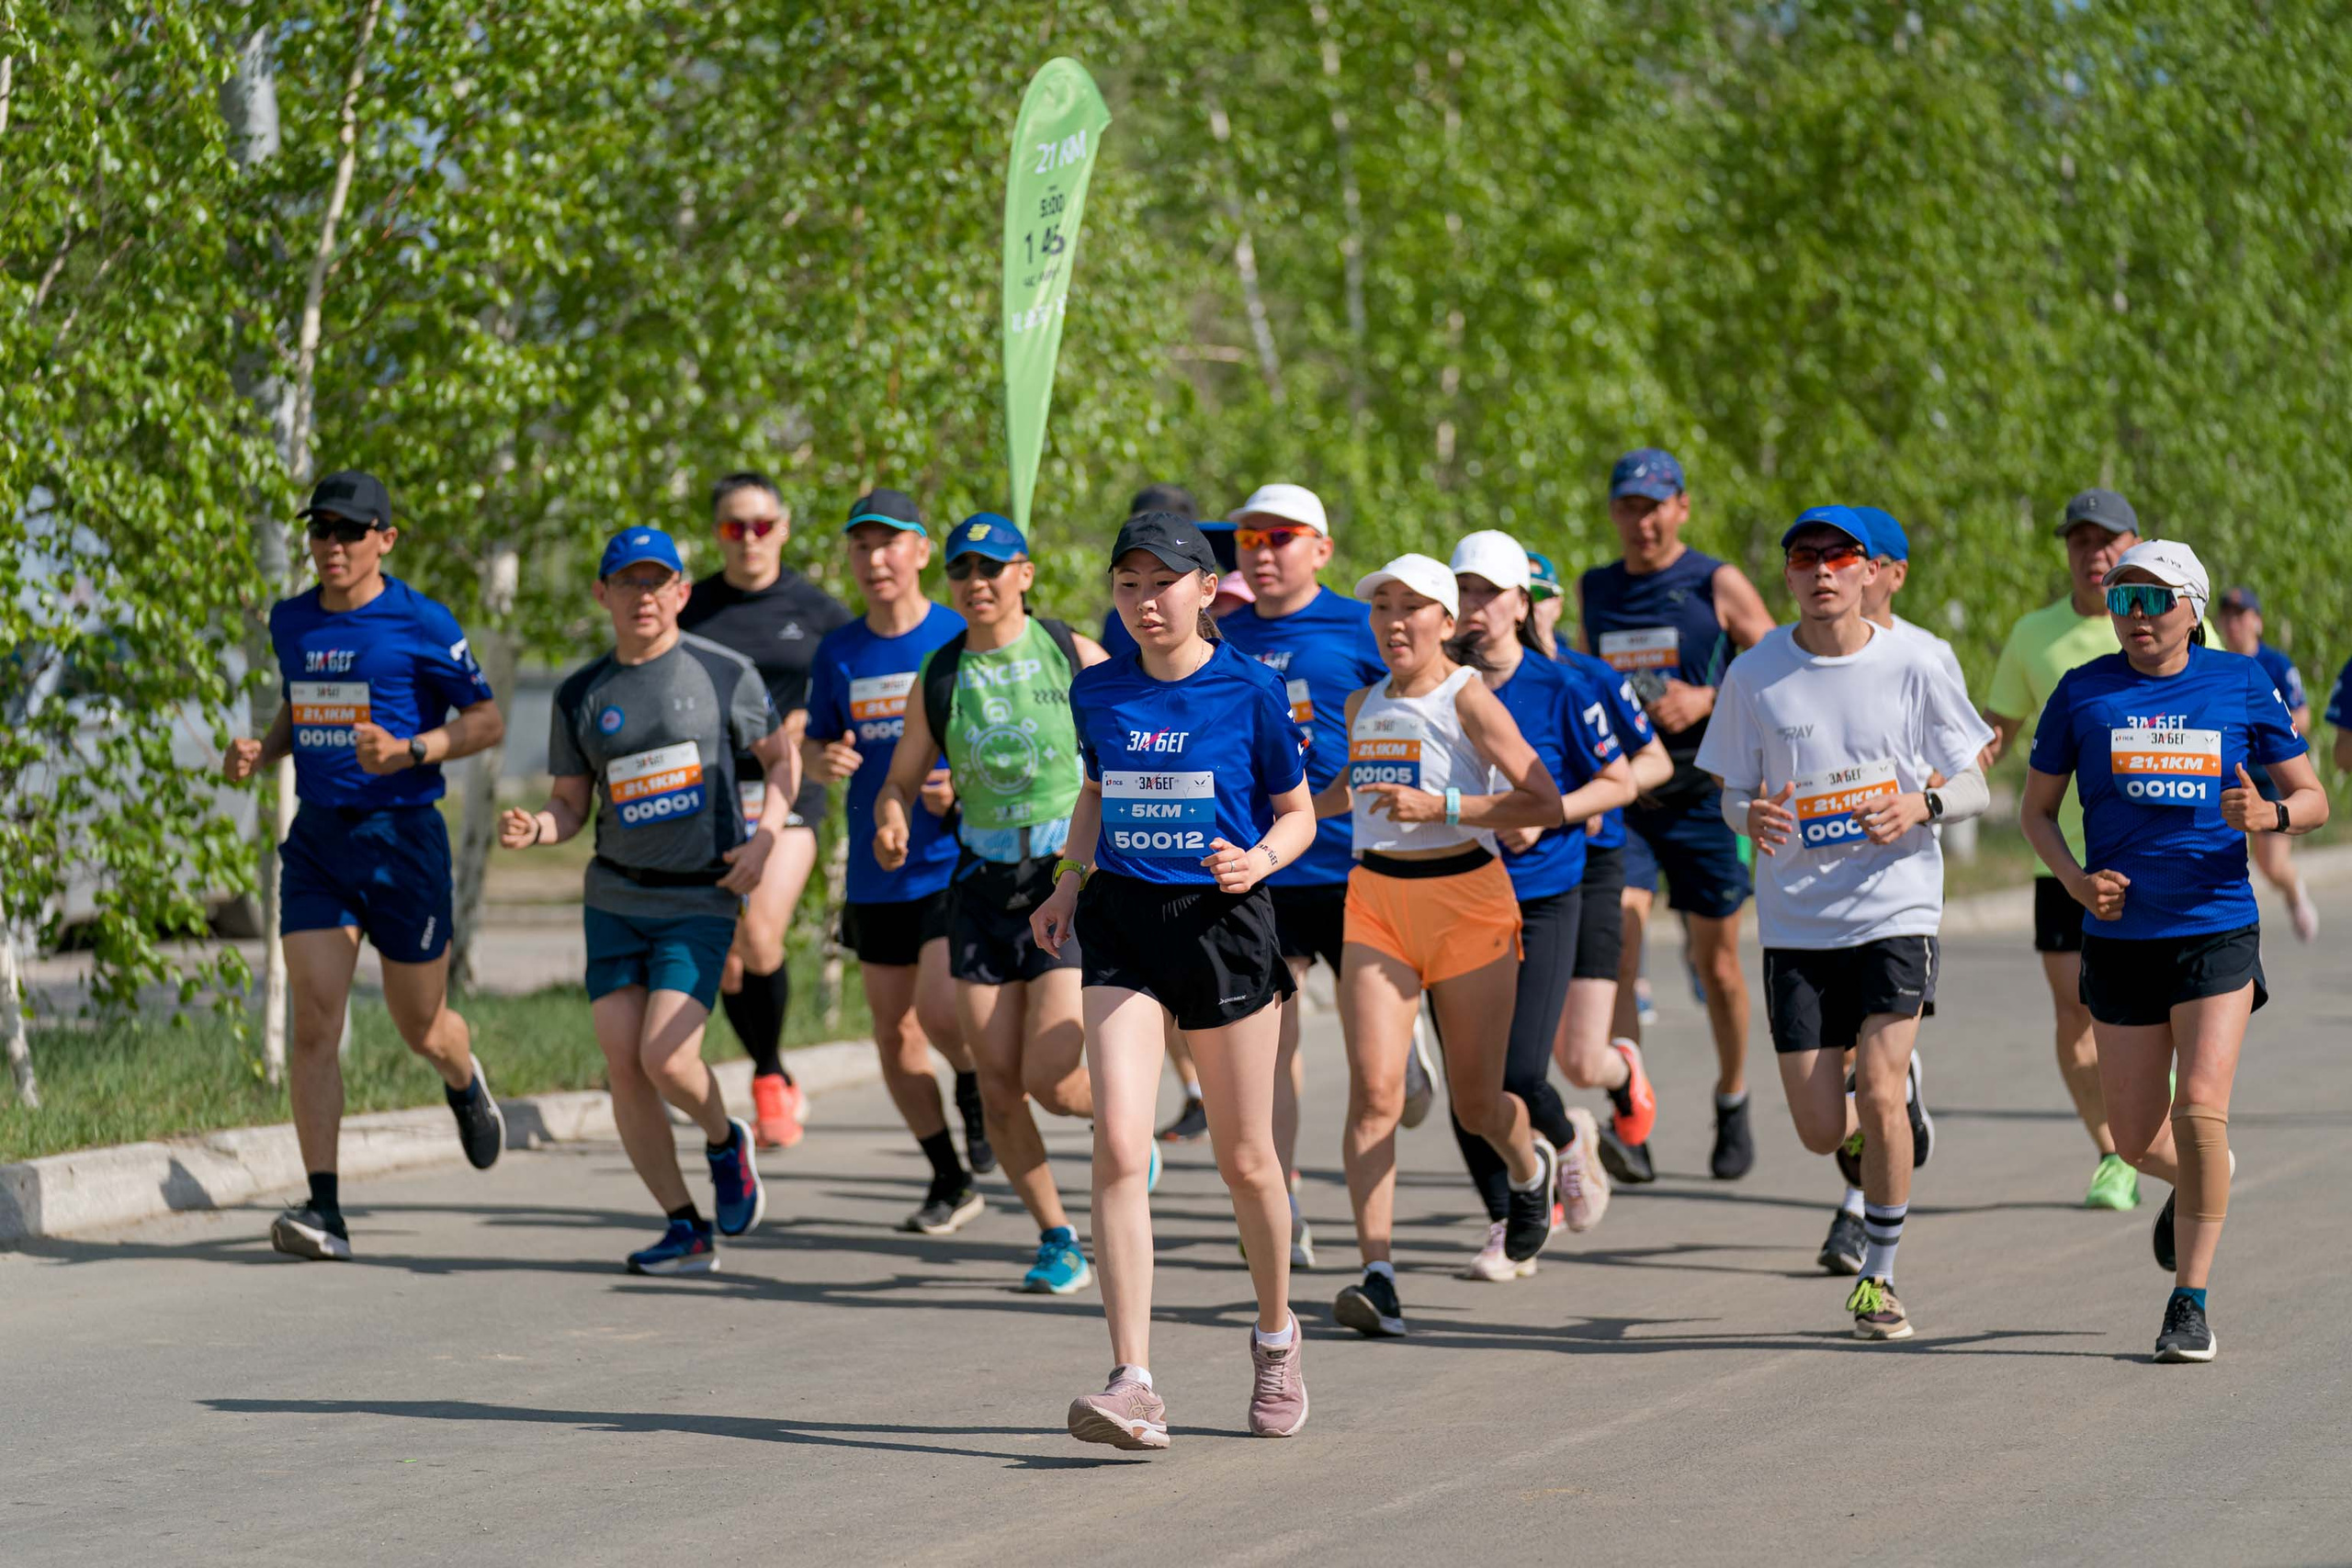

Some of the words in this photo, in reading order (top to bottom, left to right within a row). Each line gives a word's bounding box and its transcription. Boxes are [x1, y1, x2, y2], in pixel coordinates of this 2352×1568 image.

[1583, 701, 1610, 737] 7
[2129, 756, 2204, 772] 21,1KM
[1352, 766, 1413, 784] 00105
[2127, 780, 2206, 800] 00101
[623, 791, 699, 823] 00001
[1131, 804, 1182, 818] 5KM
[1114, 831, 1204, 850] 50012
